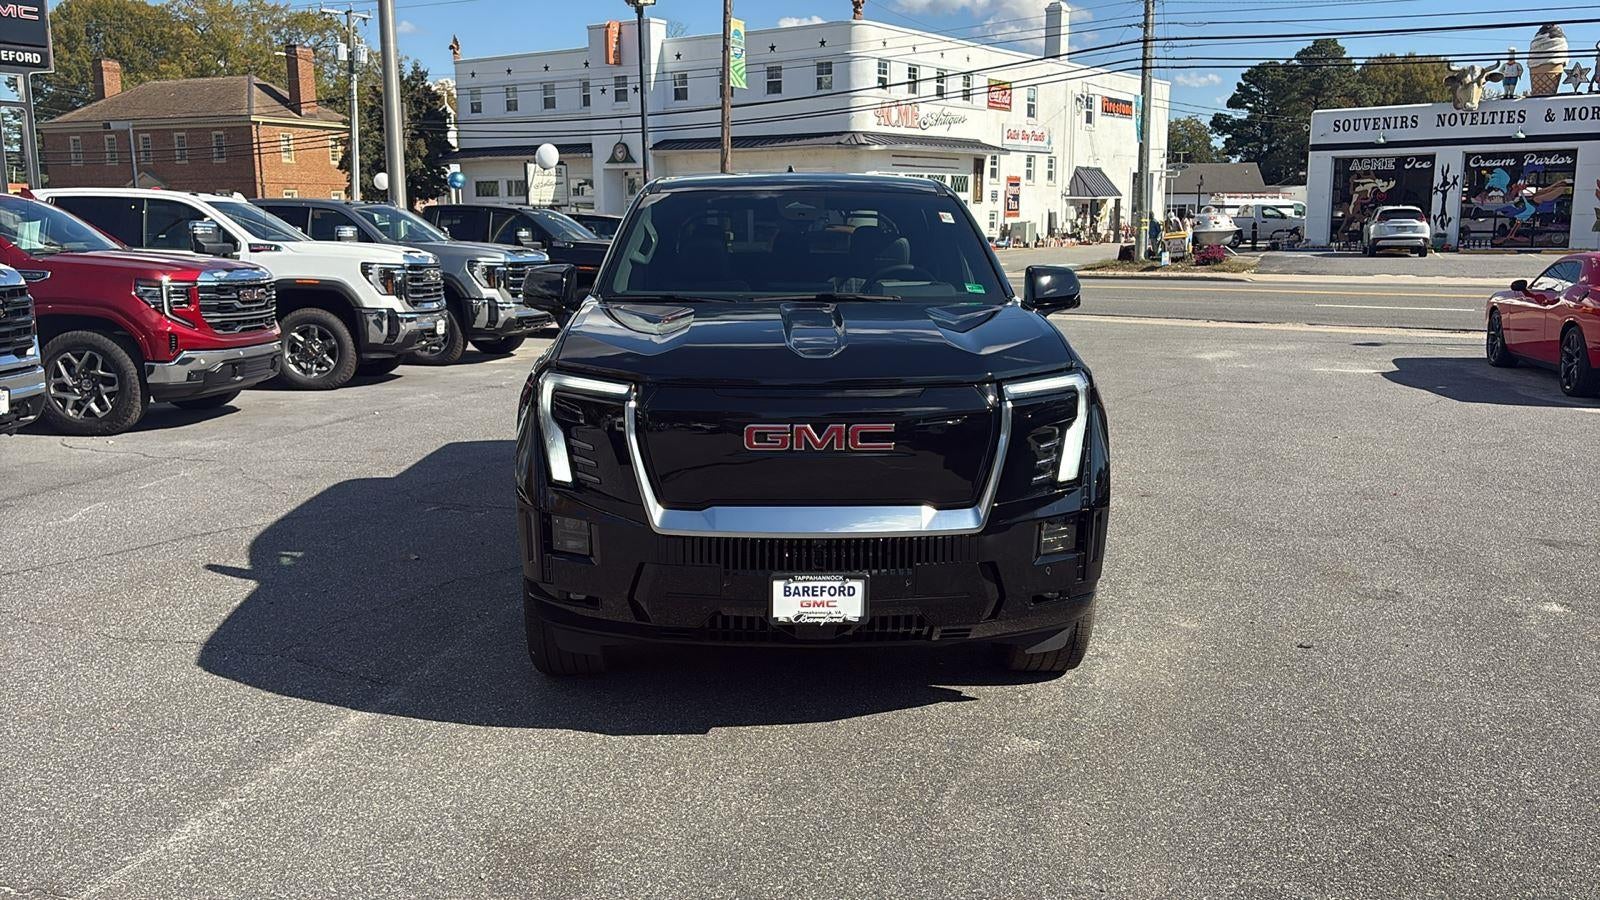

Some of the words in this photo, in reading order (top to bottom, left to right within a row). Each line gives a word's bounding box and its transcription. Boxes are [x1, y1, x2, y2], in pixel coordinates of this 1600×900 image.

[0, 4, 39, 20] MC
[1, 50, 41, 63] EFORD
[874, 100, 920, 129] ACME
[1332, 115, 1420, 133] SOUVENIRS
[1436, 109, 1527, 128] NOVELTIES
[1544, 107, 1556, 123] &
[1562, 105, 1600, 122] MOR
[1349, 157, 1396, 171] ACME
[1404, 156, 1433, 170] Ice
[1469, 154, 1517, 168] Cream
[1523, 152, 1574, 166] Parlor
[744, 424, 895, 451] GMC
[783, 585, 856, 597] BAREFORD
[800, 599, 838, 608] GMC
